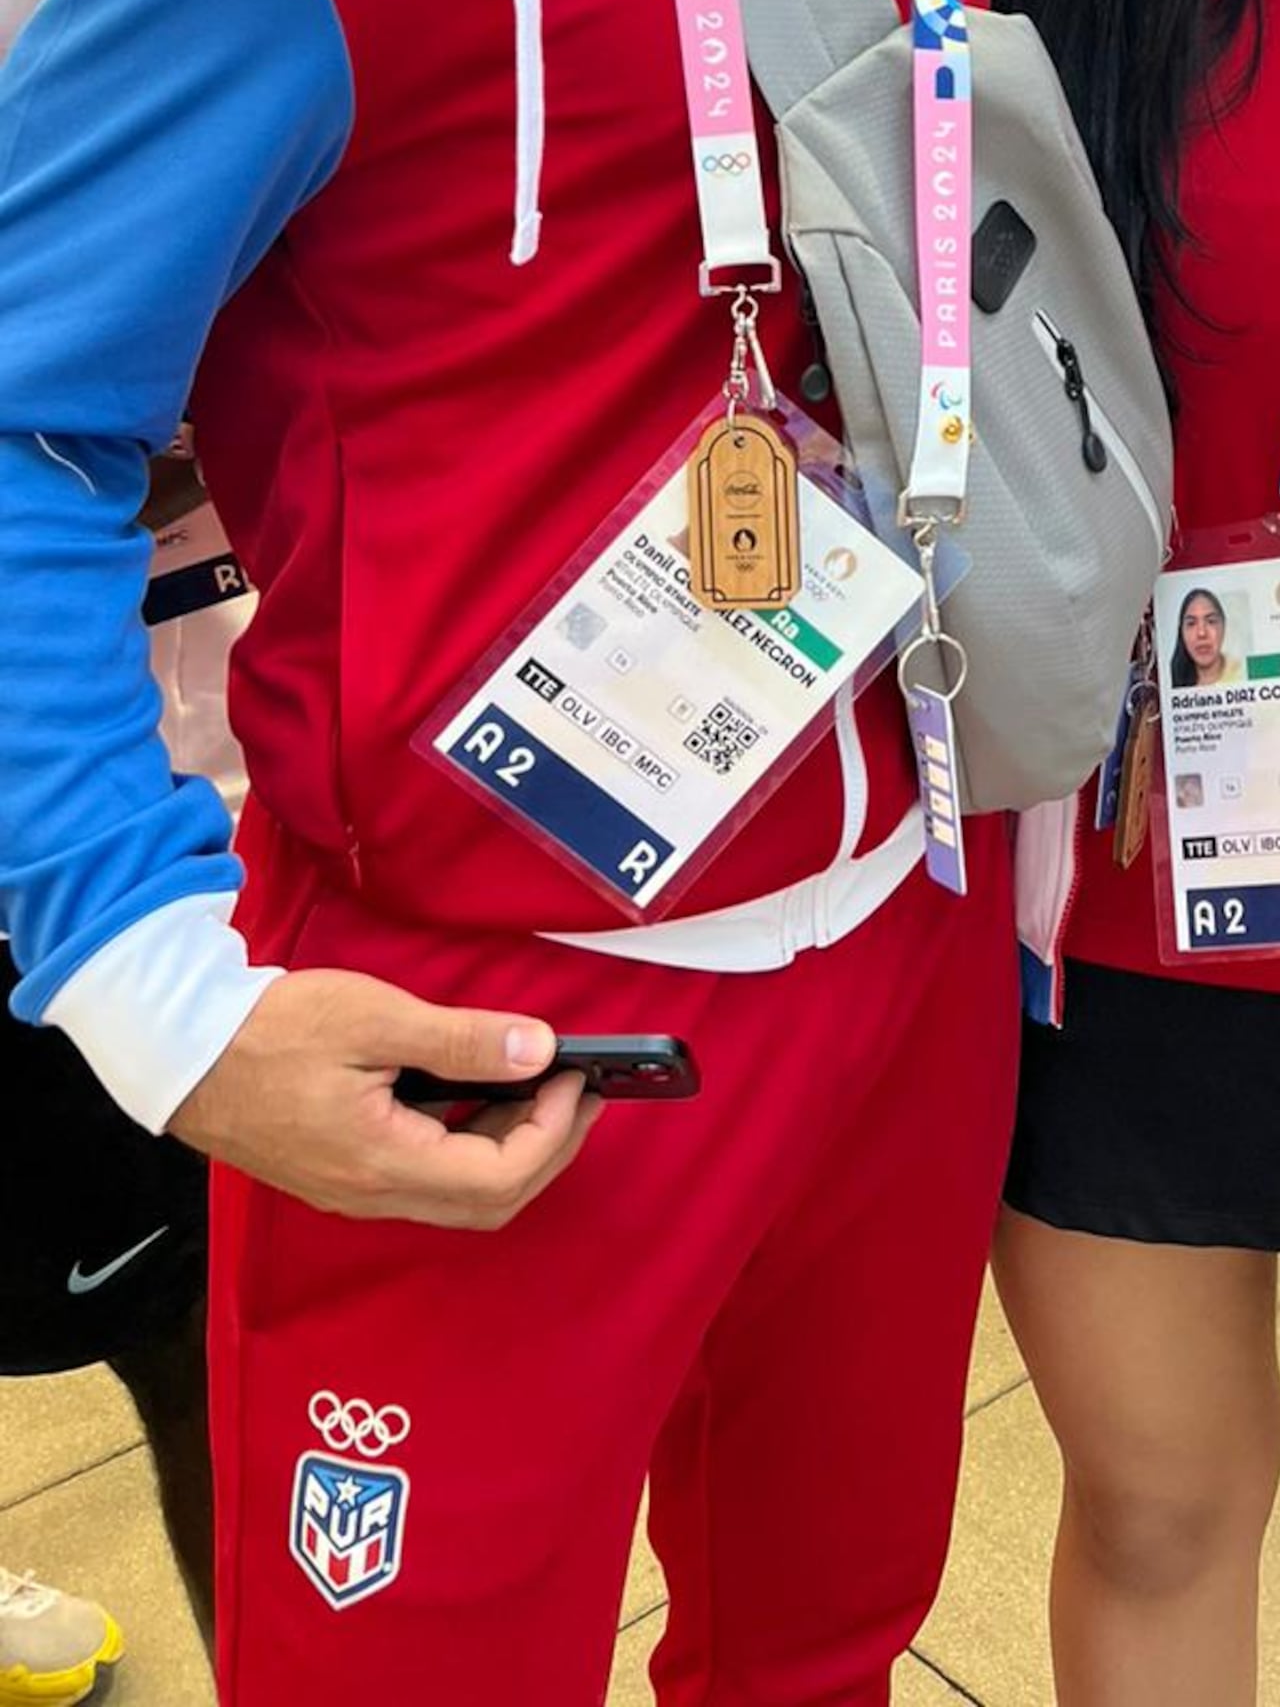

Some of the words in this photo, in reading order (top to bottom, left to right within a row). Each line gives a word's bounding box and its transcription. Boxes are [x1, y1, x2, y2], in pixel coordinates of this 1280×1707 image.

[695, 12, 732, 120] 2024
[931, 120, 957, 221] 2024
[934, 236, 957, 349] PARIS
[214, 563, 241, 593] R
[633, 533, 677, 573] Danil
[750, 629, 817, 689] NEGRON
[522, 663, 559, 700] TTE
[559, 694, 597, 730] OLV
[600, 727, 632, 756] IBC
[634, 754, 673, 789] MPC
[1171, 694, 1223, 710] Adriana
[1226, 687, 1256, 705] DIAZ
[463, 721, 506, 765] A
[494, 746, 536, 787] 2
[618, 840, 658, 884] R
[1184, 840, 1215, 856] TTE
[1221, 839, 1251, 854] OLV
[1193, 899, 1217, 937] A
[1224, 899, 1247, 935] 2
